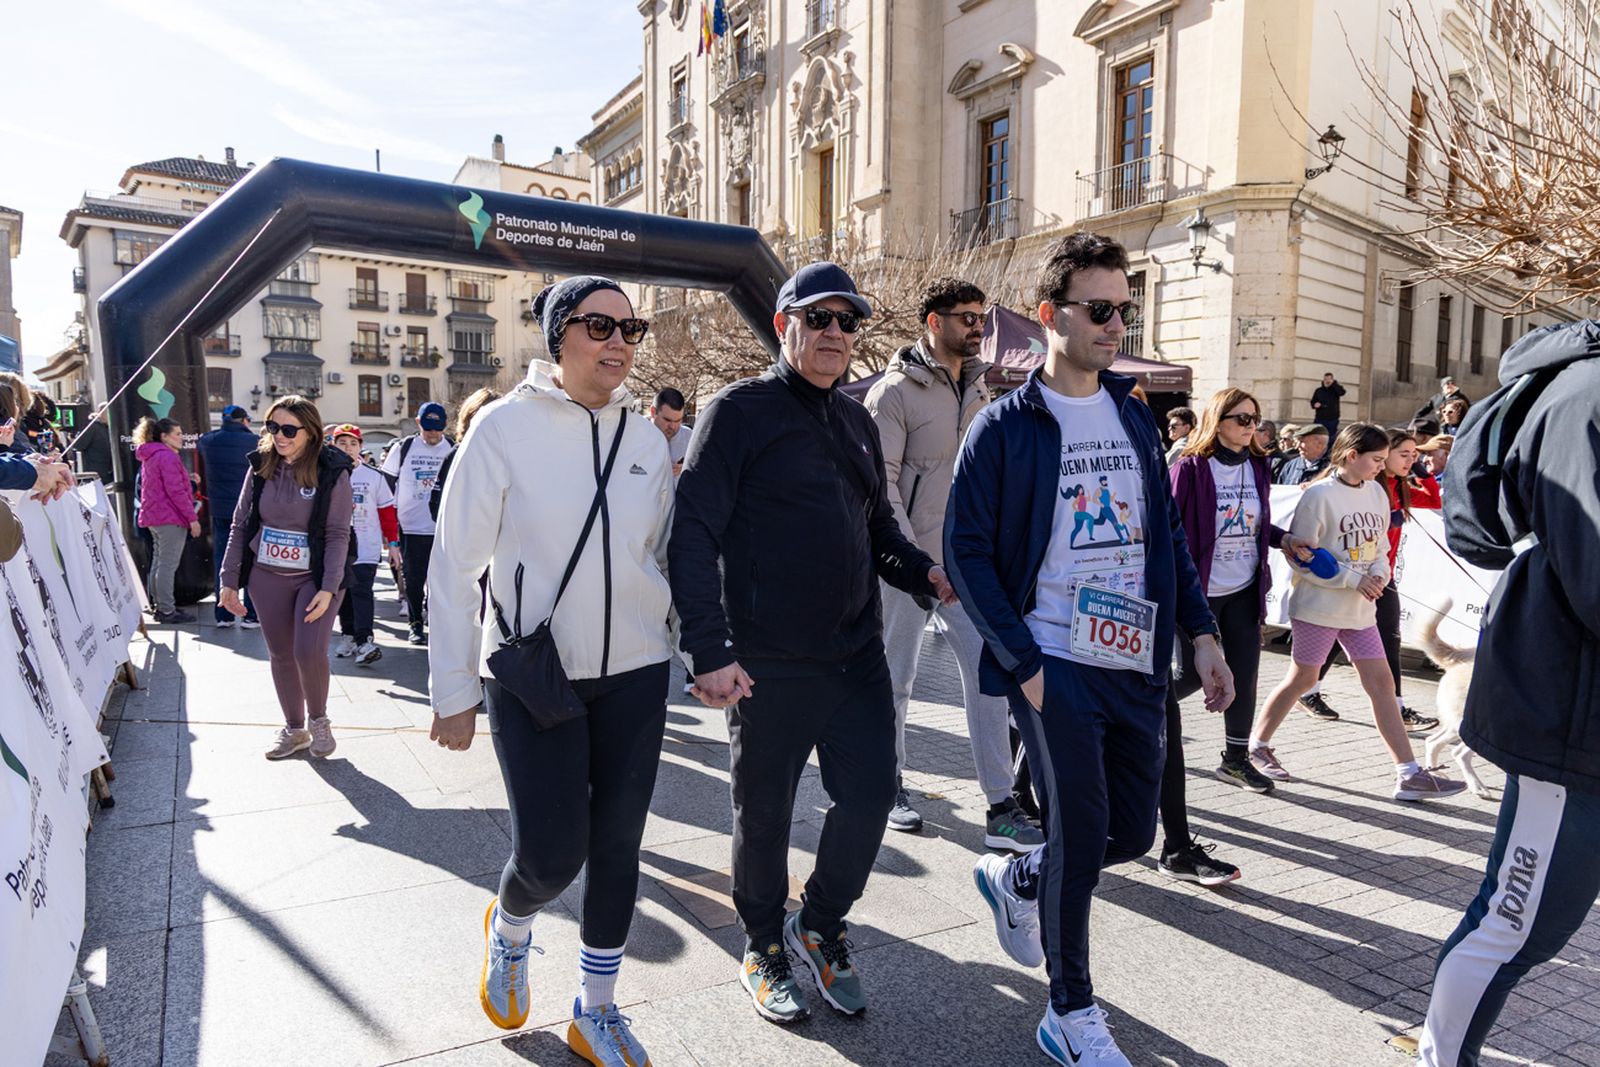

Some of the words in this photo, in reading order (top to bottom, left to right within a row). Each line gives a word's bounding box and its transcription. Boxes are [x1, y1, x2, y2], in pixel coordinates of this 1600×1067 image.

[495, 212, 558, 232] Patronato
[560, 221, 618, 240] Municipal
[620, 229, 637, 242] de
[495, 227, 554, 247] Deportes
[557, 235, 573, 249] de
[576, 238, 605, 252] Jaén
[1061, 440, 1103, 455] CARRERA
[1104, 440, 1132, 449] CAMIN
[1060, 458, 1089, 476] UENA
[1090, 455, 1134, 473] MUERTE
[1340, 511, 1384, 534] GOOD
[266, 543, 300, 561] 1068
[1087, 602, 1111, 616] BUENA
[1112, 607, 1137, 624] MUERTE
[1089, 616, 1142, 654] 1056
